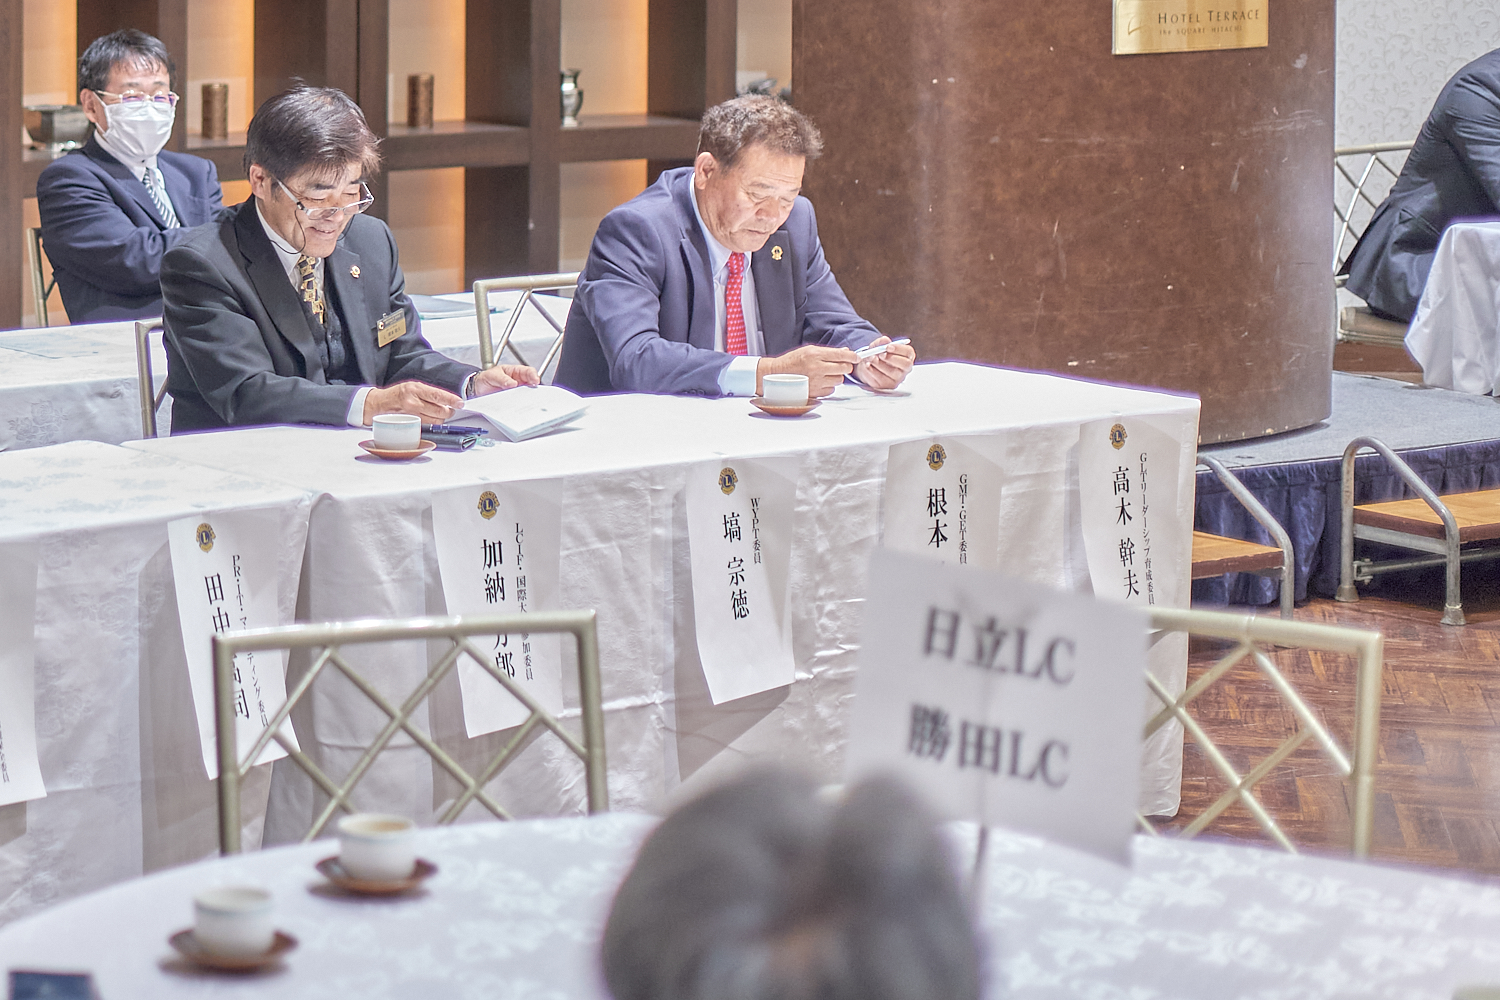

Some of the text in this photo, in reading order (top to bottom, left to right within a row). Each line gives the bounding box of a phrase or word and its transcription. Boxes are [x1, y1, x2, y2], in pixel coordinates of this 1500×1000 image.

[1158, 9, 1259, 24] HOTEL TERRACE
[750, 498, 762, 564] WYPT委員
[926, 487, 948, 549] 根本
[1112, 466, 1140, 600] 高木 幹夫
[204, 572, 230, 634] 田中
[480, 539, 506, 604] 加納
[515, 522, 534, 681] LCIF・国際大加委員
[727, 556, 750, 620] 宗徳
[921, 605, 1077, 686] 日立LC
[907, 702, 1070, 789] 勝田LC
